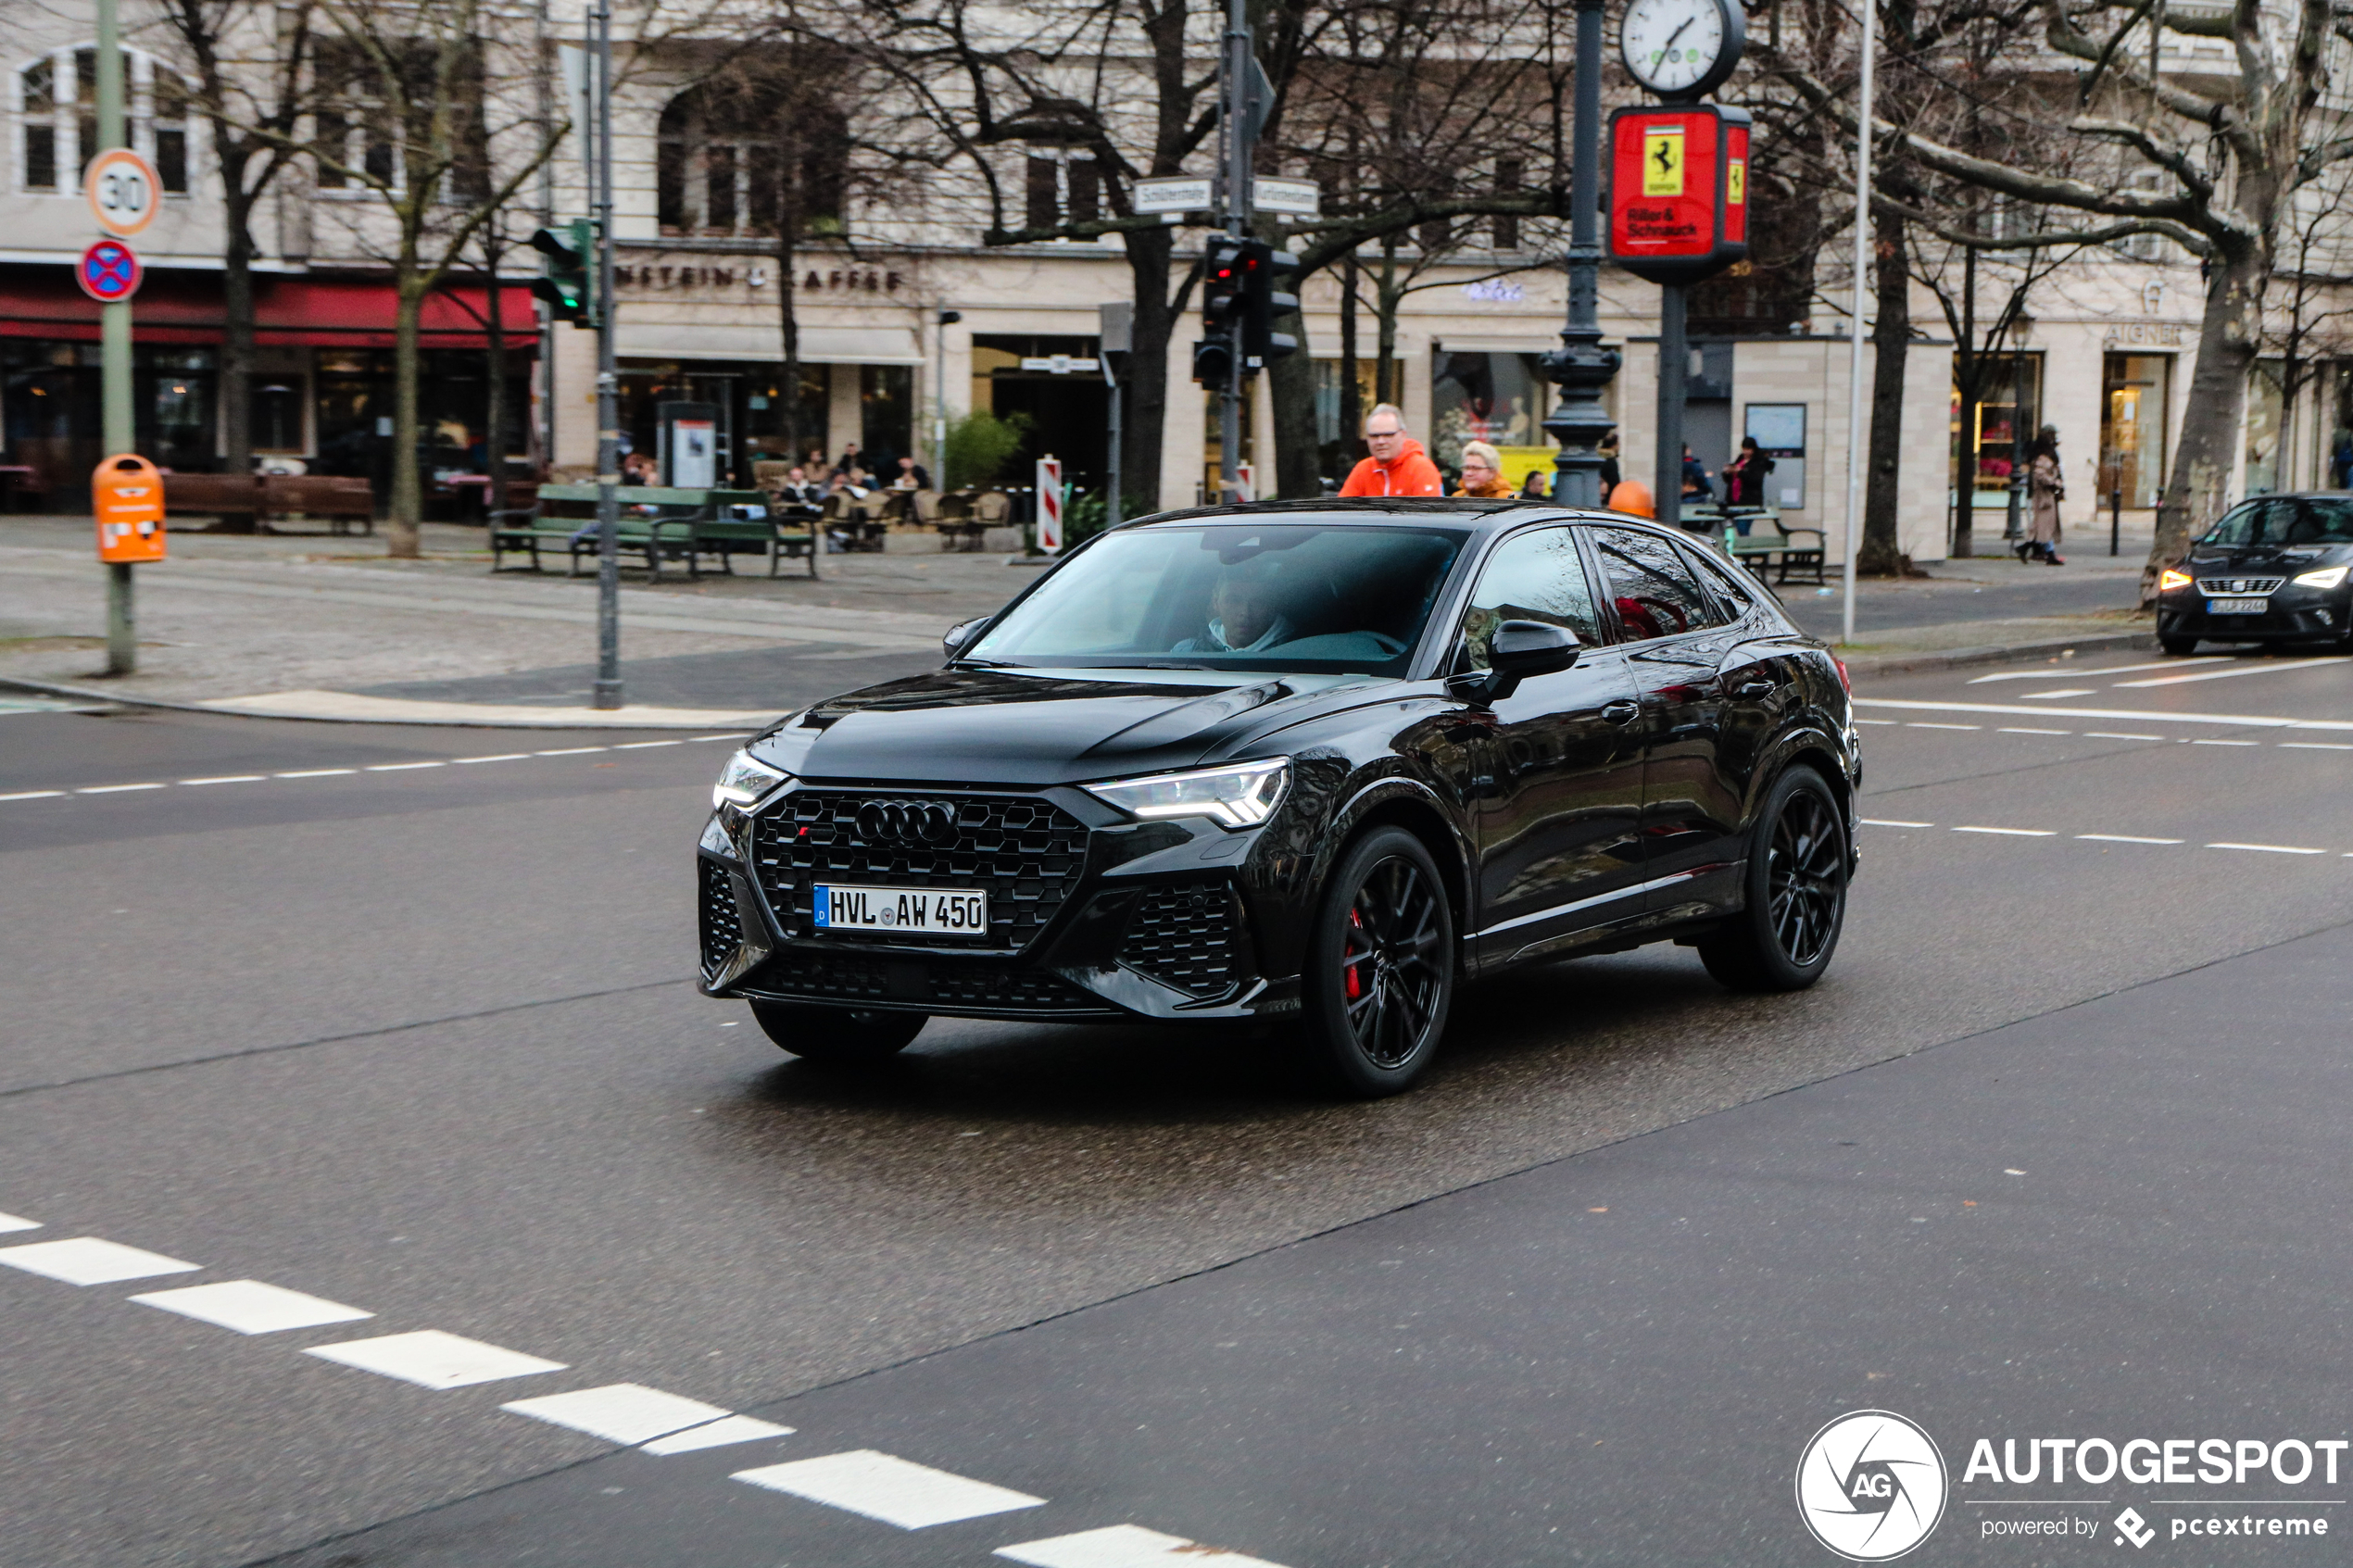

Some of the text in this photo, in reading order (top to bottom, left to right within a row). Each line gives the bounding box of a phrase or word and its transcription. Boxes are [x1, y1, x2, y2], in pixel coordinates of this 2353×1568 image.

[103, 173, 146, 212] 30
[1664, 207, 1674, 221] &
[1627, 223, 1697, 237] Schnauck
[789, 270, 901, 291] AFFEE
[2104, 324, 2182, 345] AIGNER
[818, 910, 825, 921] D
[831, 891, 982, 929] HVL AW 450
